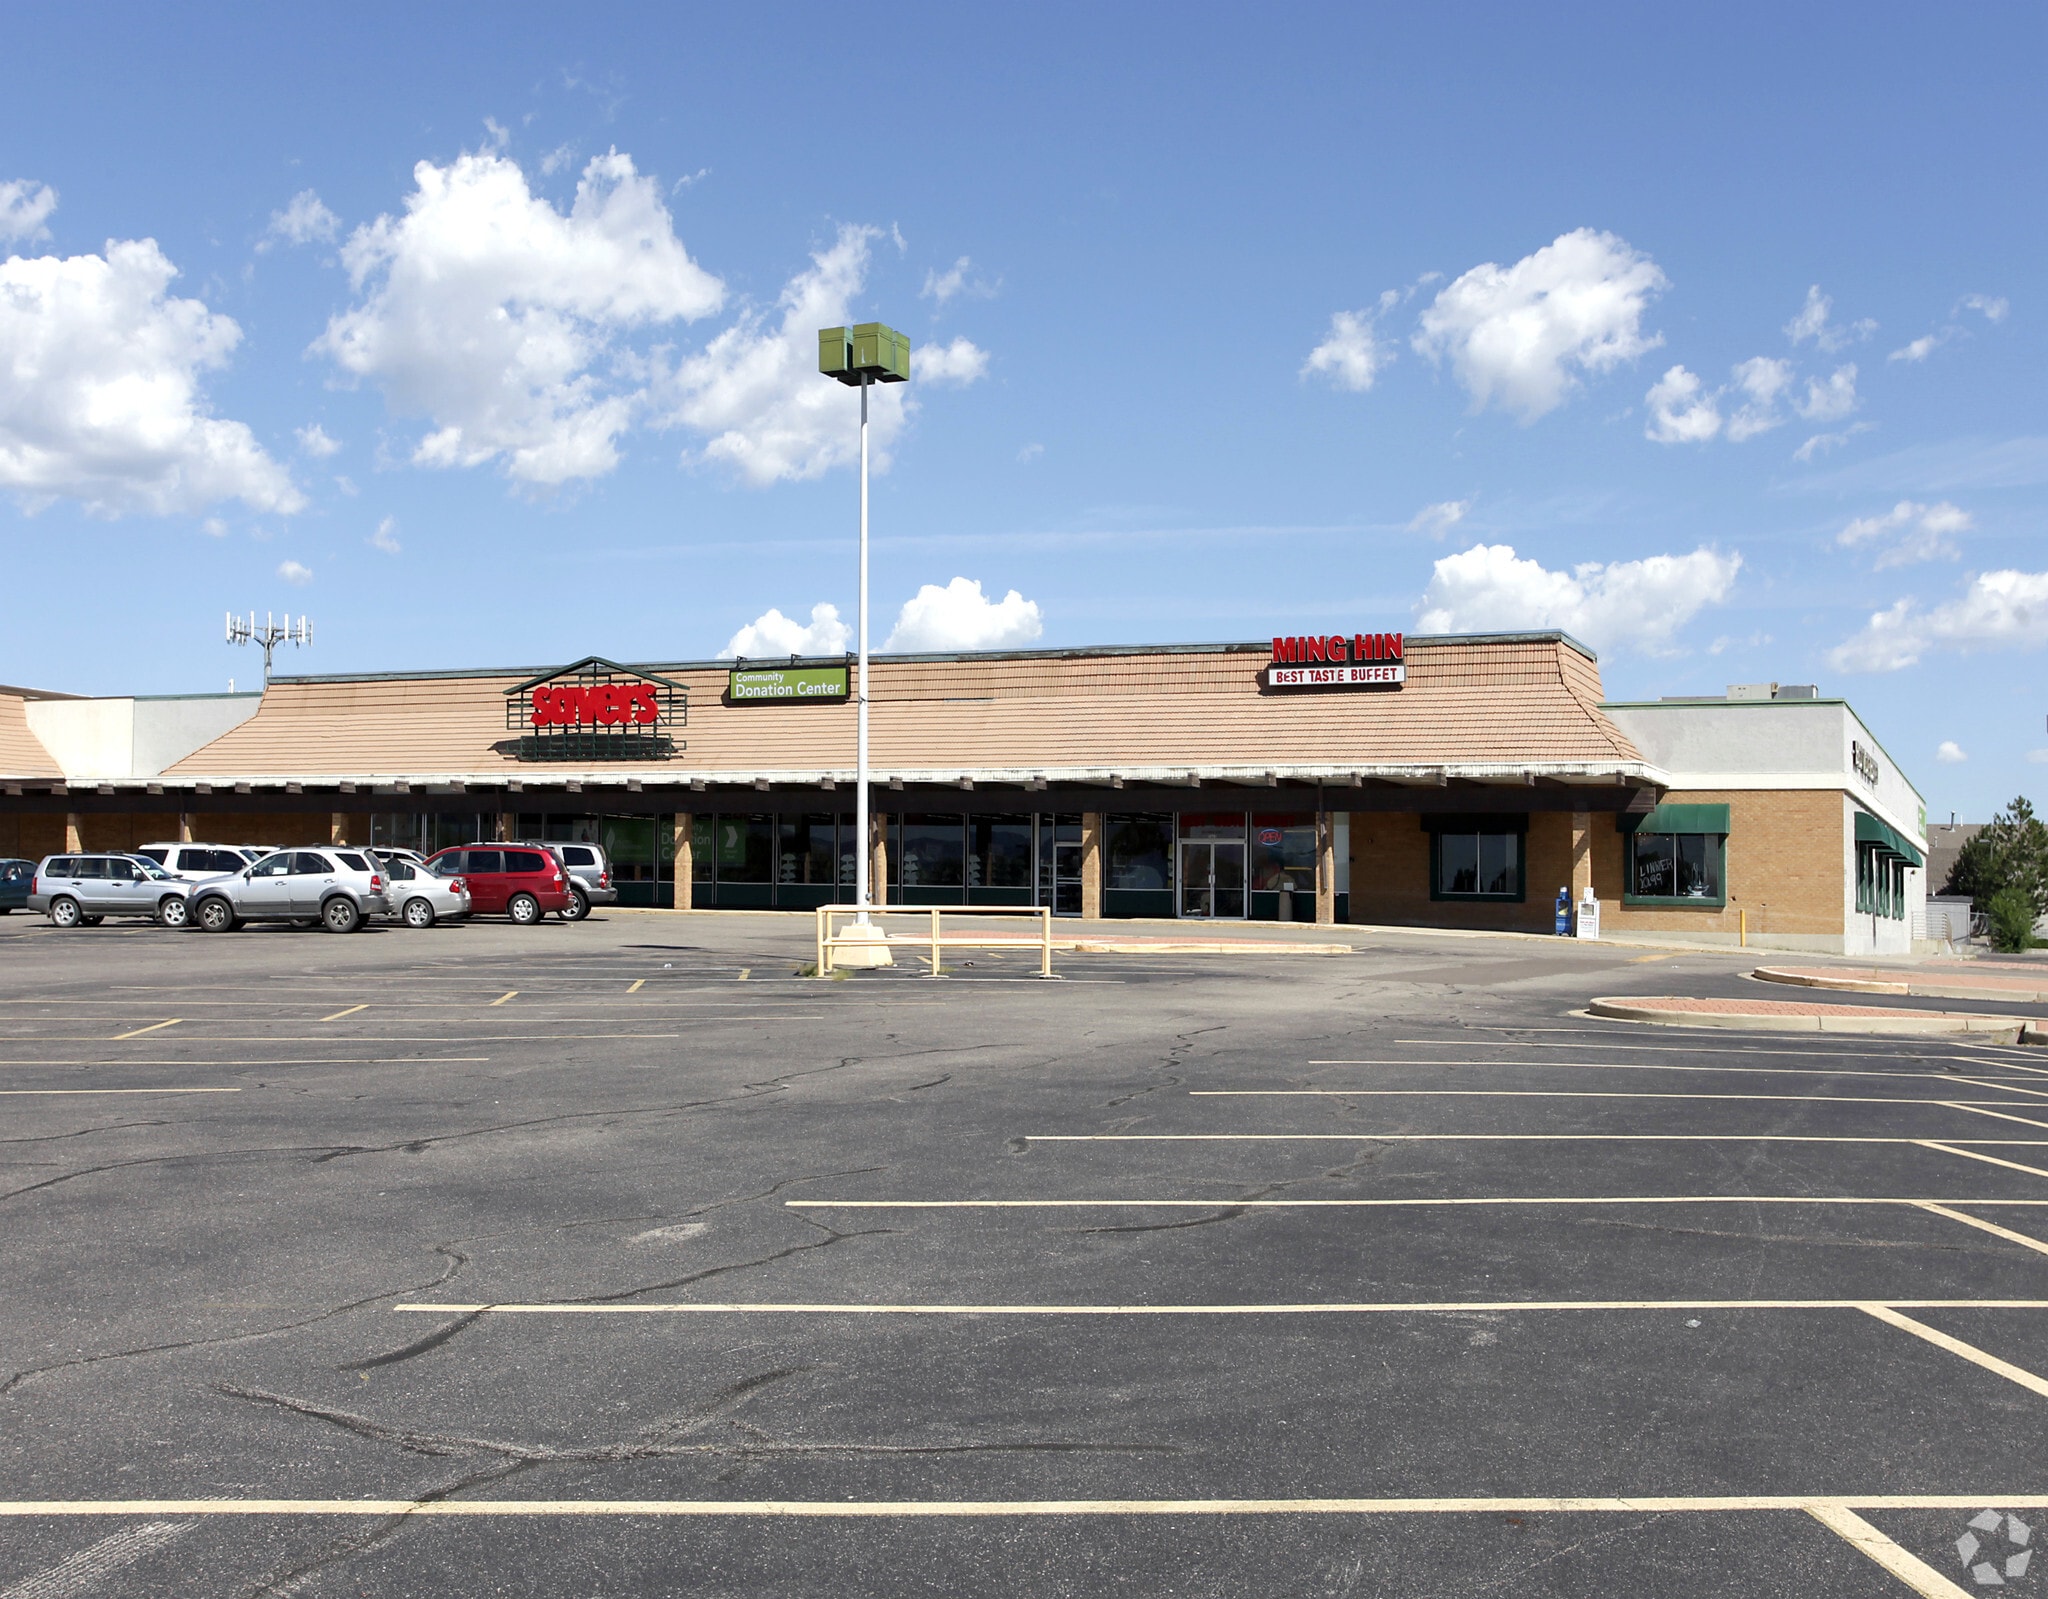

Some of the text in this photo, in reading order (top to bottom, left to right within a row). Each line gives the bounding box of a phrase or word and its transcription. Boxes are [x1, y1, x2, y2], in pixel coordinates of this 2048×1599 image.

[1272, 633, 1404, 663] MING HIN
[736, 672, 784, 682] Community
[1276, 668, 1397, 683] BEST TASTE BUFFET
[735, 681, 841, 697] Donation Center
[1258, 831, 1282, 843] OPEN
